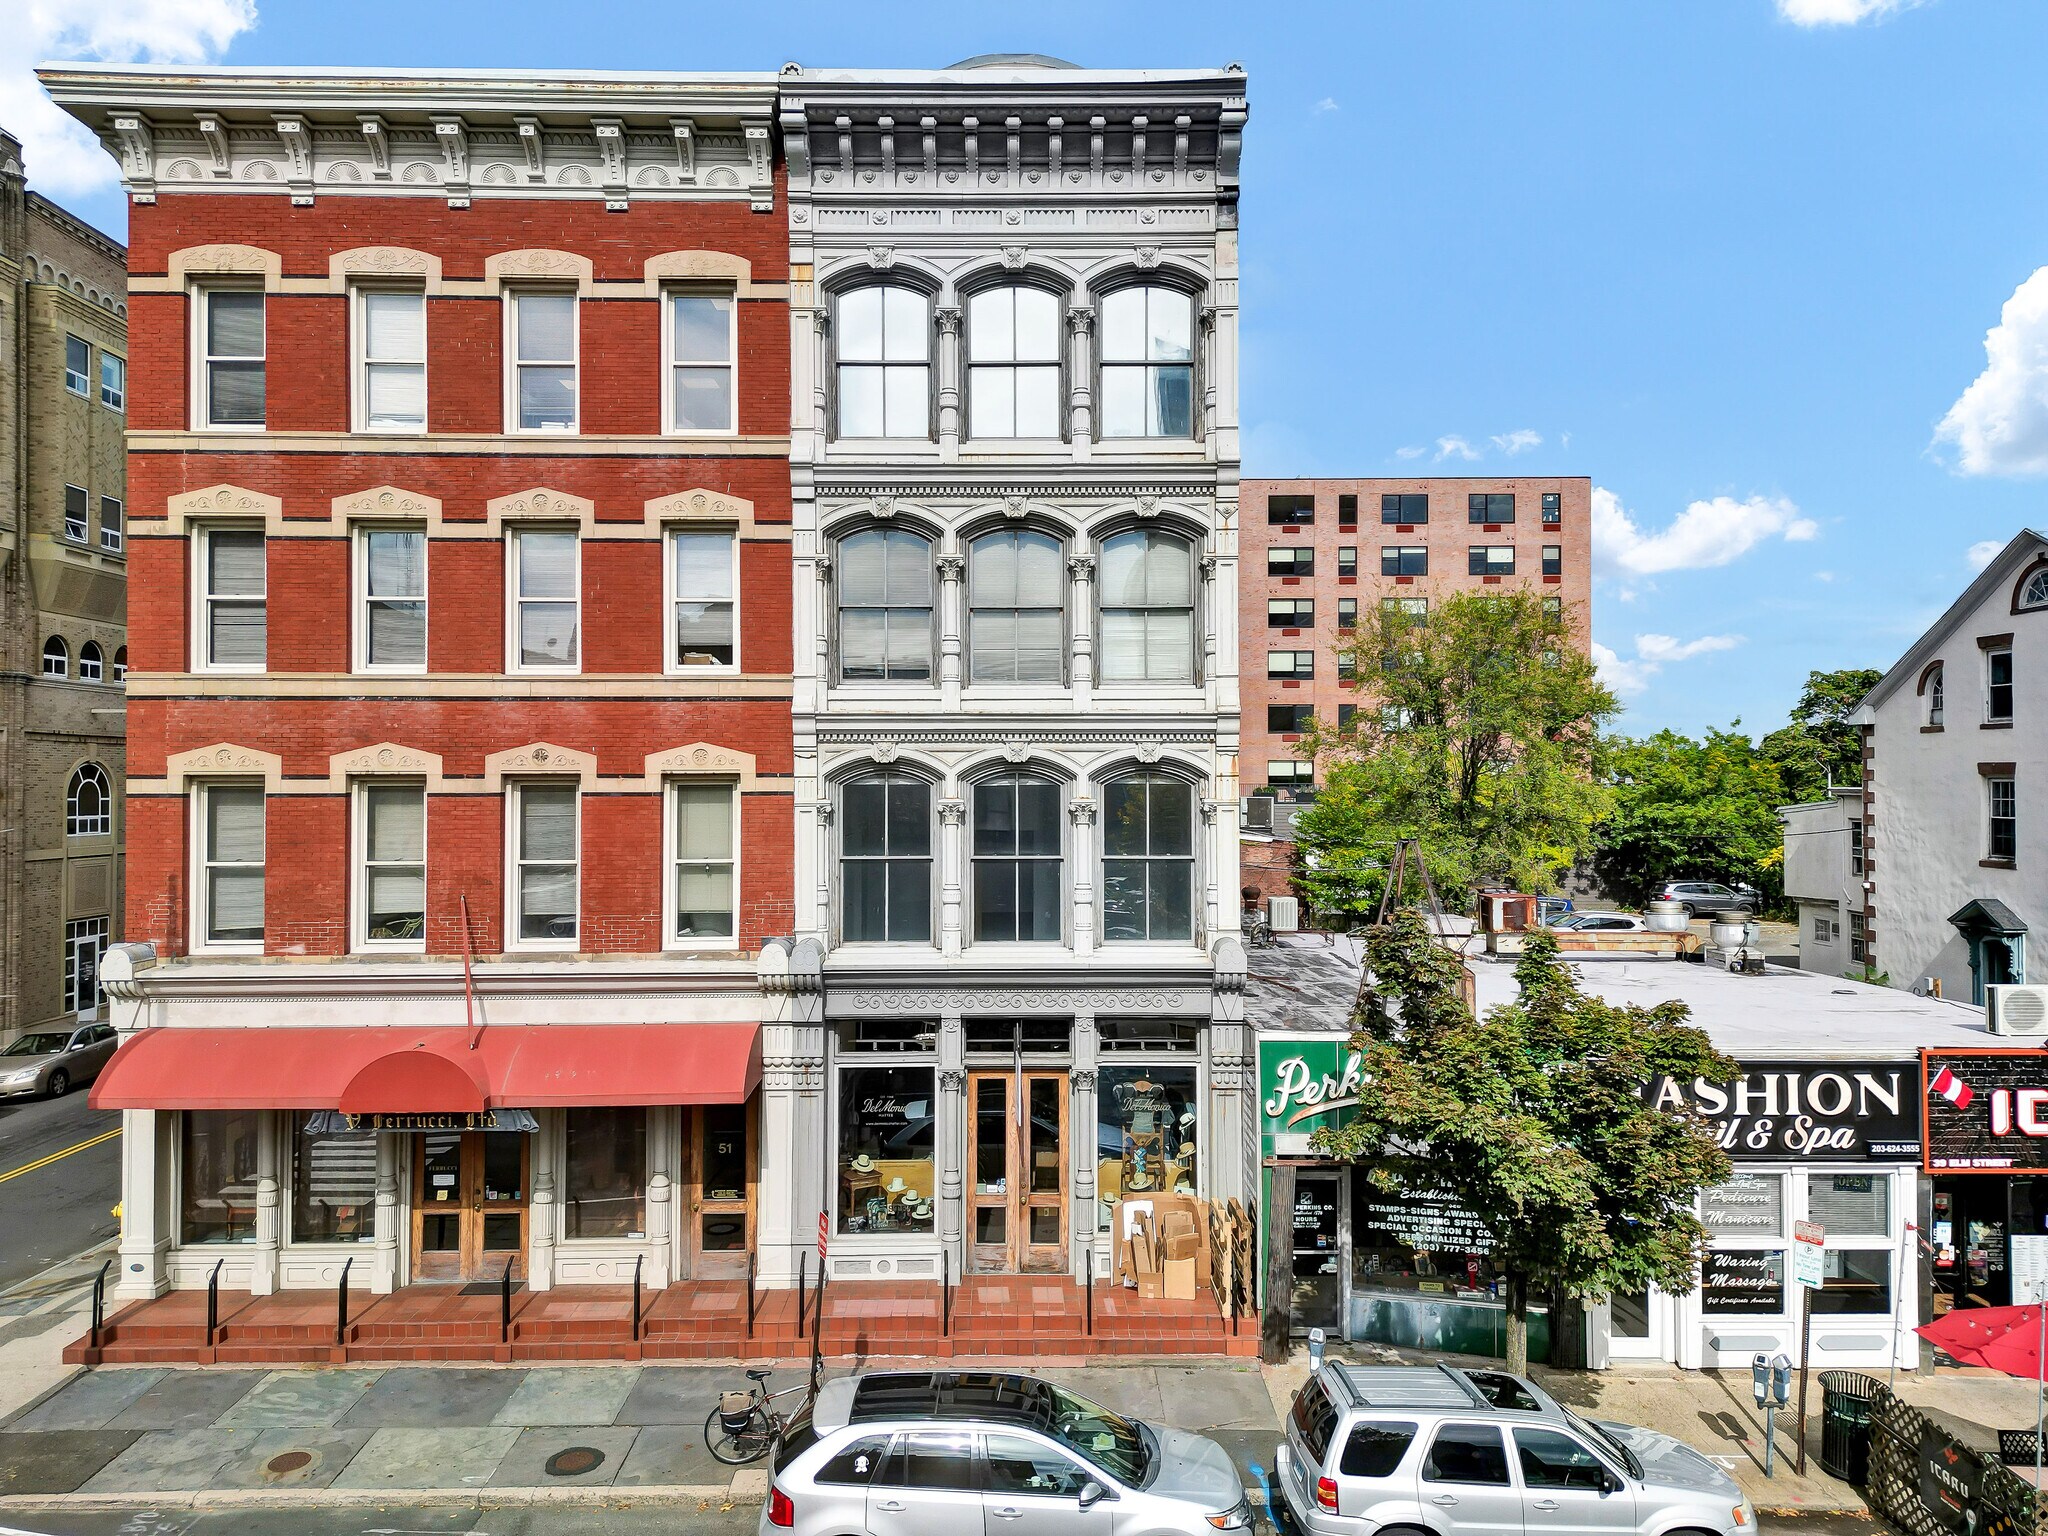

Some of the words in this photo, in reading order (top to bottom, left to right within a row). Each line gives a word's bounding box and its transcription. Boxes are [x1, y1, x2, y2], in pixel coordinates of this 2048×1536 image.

[1265, 1051, 1373, 1118] Perk
[1631, 1073, 1901, 1117] ASHION
[1746, 1118, 1773, 1150] &
[1785, 1115, 1856, 1156] Spa
[718, 1143, 732, 1154] 51
[1870, 1144, 1921, 1153] 203-624-3555
[1932, 1158, 1948, 1168] 39
[1948, 1158, 1971, 1168] ELM
[1971, 1158, 2013, 1168] STREET
[1838, 1176, 1869, 1187] OPEN
[1400, 1187, 1464, 1202] Establishe
[1708, 1189, 1772, 1204] Pedicure
[1386, 1214, 1451, 1226] ADVERTISING
[1706, 1210, 1775, 1226] Manicure
[1368, 1221, 1409, 1231] SPECIAL
[1411, 1224, 1462, 1235] OCCASION
[1465, 1228, 1474, 1236] &
[1399, 1232, 1472, 1245] PERSONALIZED
[1412, 1241, 1440, 1252] (203)
[1443, 1245, 1490, 1255] 777-3456
[1713, 1253, 1769, 1271] Waxing
[1709, 1273, 1774, 1291] Massage
[1706, 1296, 1719, 1305] Gift
[1719, 1296, 1749, 1304] Certificate
[1750, 1296, 1776, 1304] Available
[1929, 1459, 1969, 1499] ICARU
